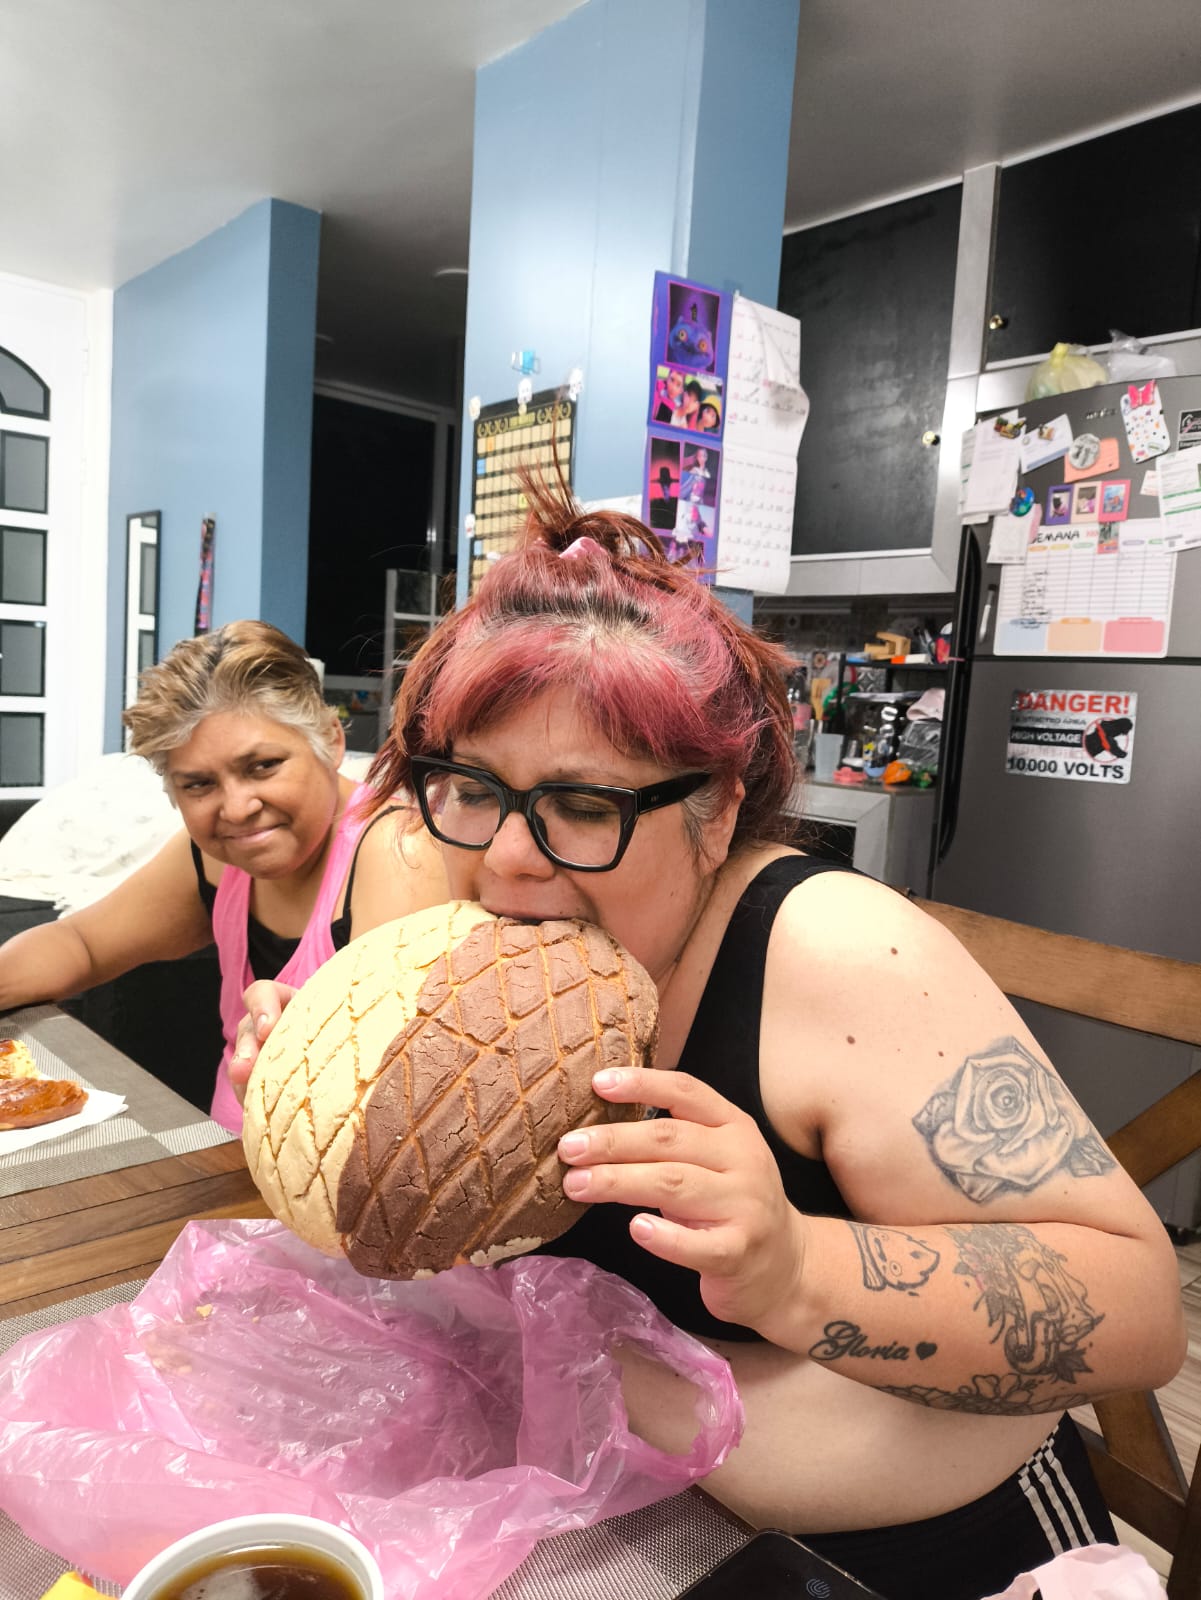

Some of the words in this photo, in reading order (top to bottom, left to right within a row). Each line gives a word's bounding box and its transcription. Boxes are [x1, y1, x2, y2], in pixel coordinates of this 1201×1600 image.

[1032, 530, 1080, 543] EMANA
[1017, 691, 1130, 714] DANGER!
[1036, 732, 1081, 744] VOLTAGE
[1064, 761, 1124, 779] VOLTS
[808, 1320, 910, 1360] Gloria
